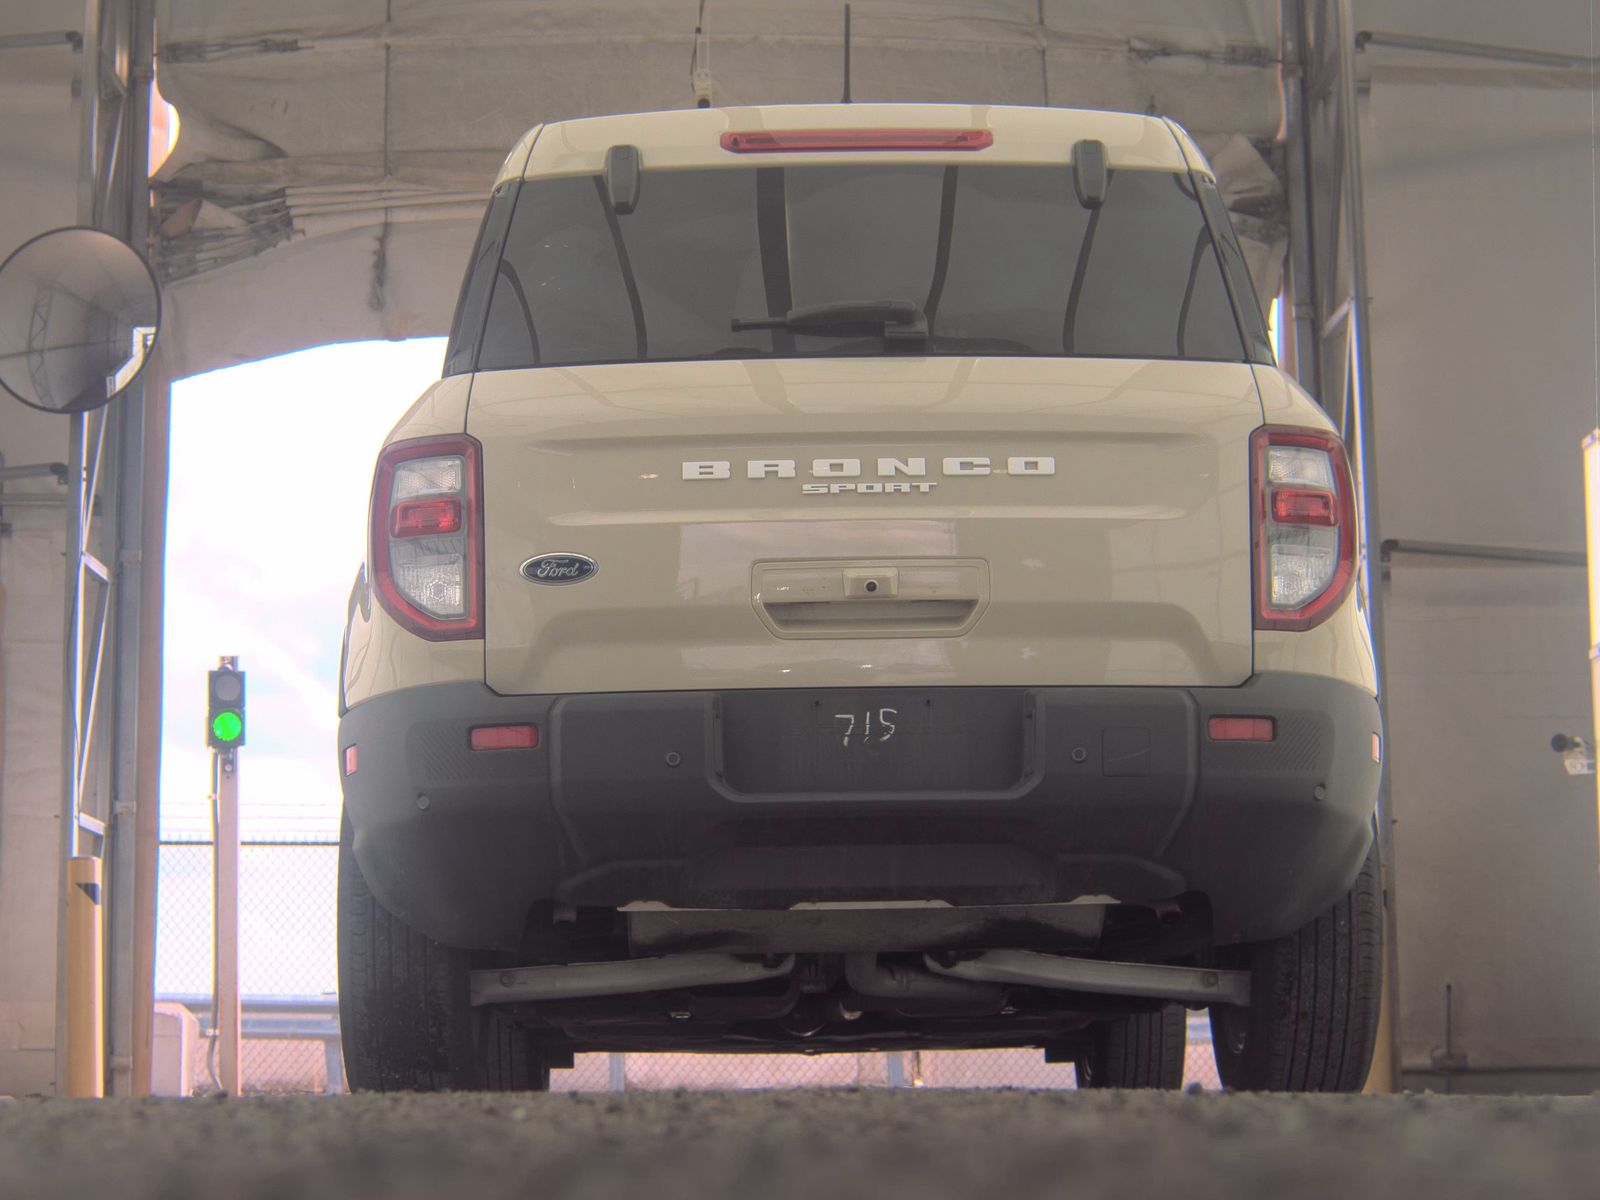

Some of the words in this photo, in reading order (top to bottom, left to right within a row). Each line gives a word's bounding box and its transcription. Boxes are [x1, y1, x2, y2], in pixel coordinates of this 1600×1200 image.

[682, 456, 1055, 481] BRONCO
[801, 481, 938, 495] SPORT
[536, 559, 580, 578] Ford
[834, 707, 898, 747] 715
